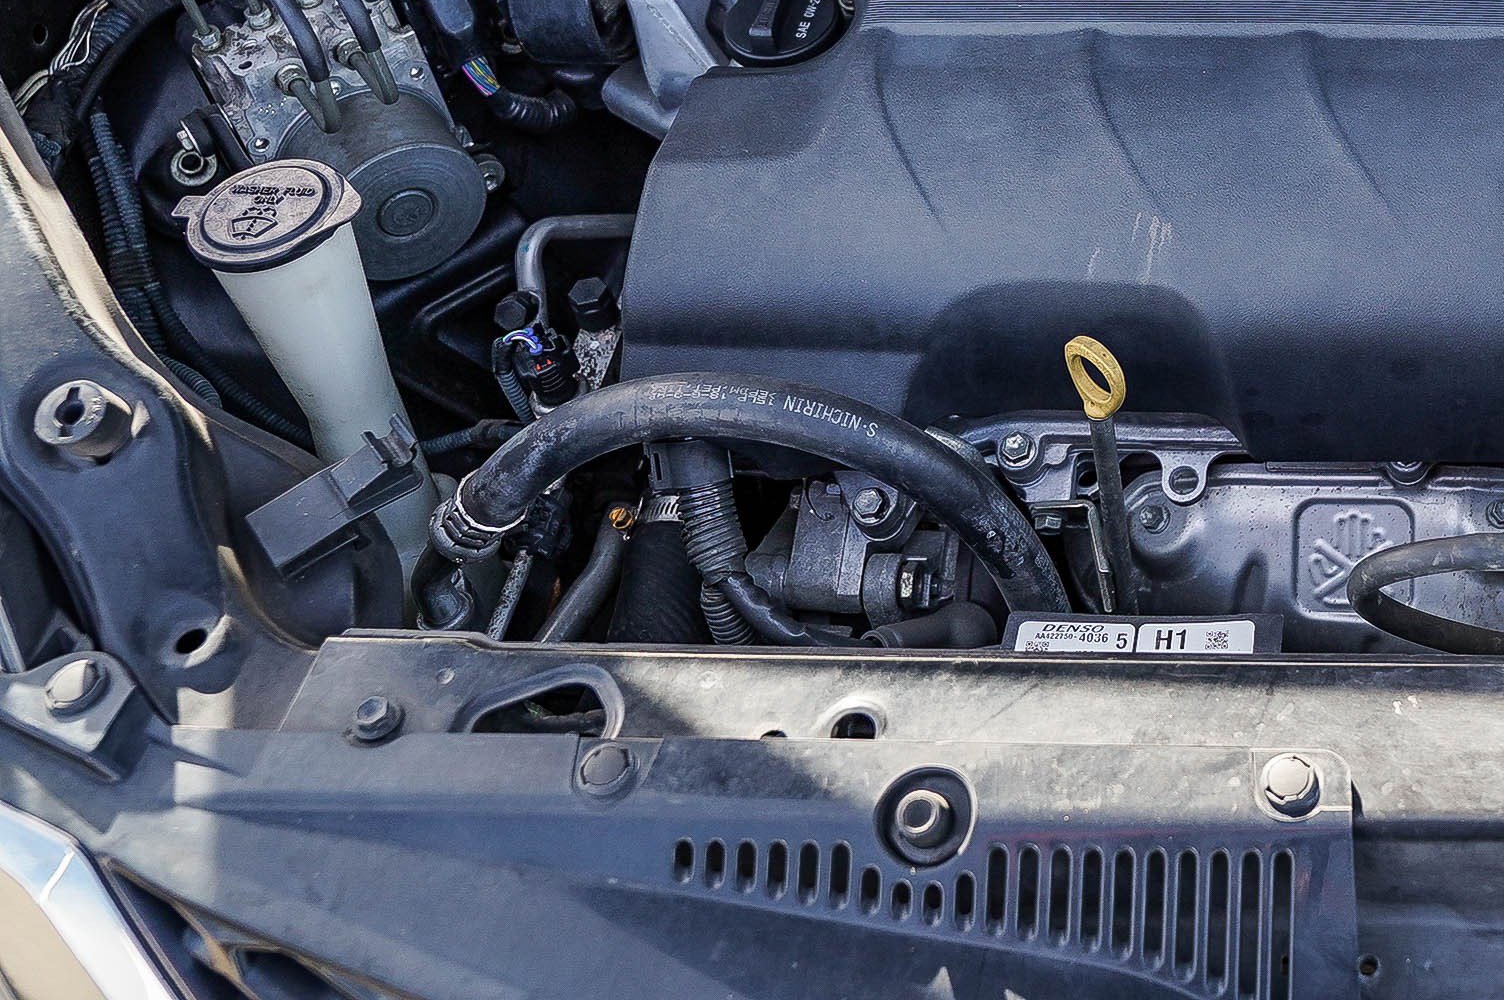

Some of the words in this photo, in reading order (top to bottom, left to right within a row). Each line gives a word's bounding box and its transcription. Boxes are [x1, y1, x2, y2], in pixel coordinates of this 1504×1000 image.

[795, 21, 811, 39] SAE
[231, 184, 280, 196] WASHER
[283, 186, 316, 197] FLUID
[254, 196, 285, 205] ONLY
[1042, 623, 1105, 633] DENSO
[1115, 633, 1128, 650] 5
[1154, 629, 1188, 650] H1
